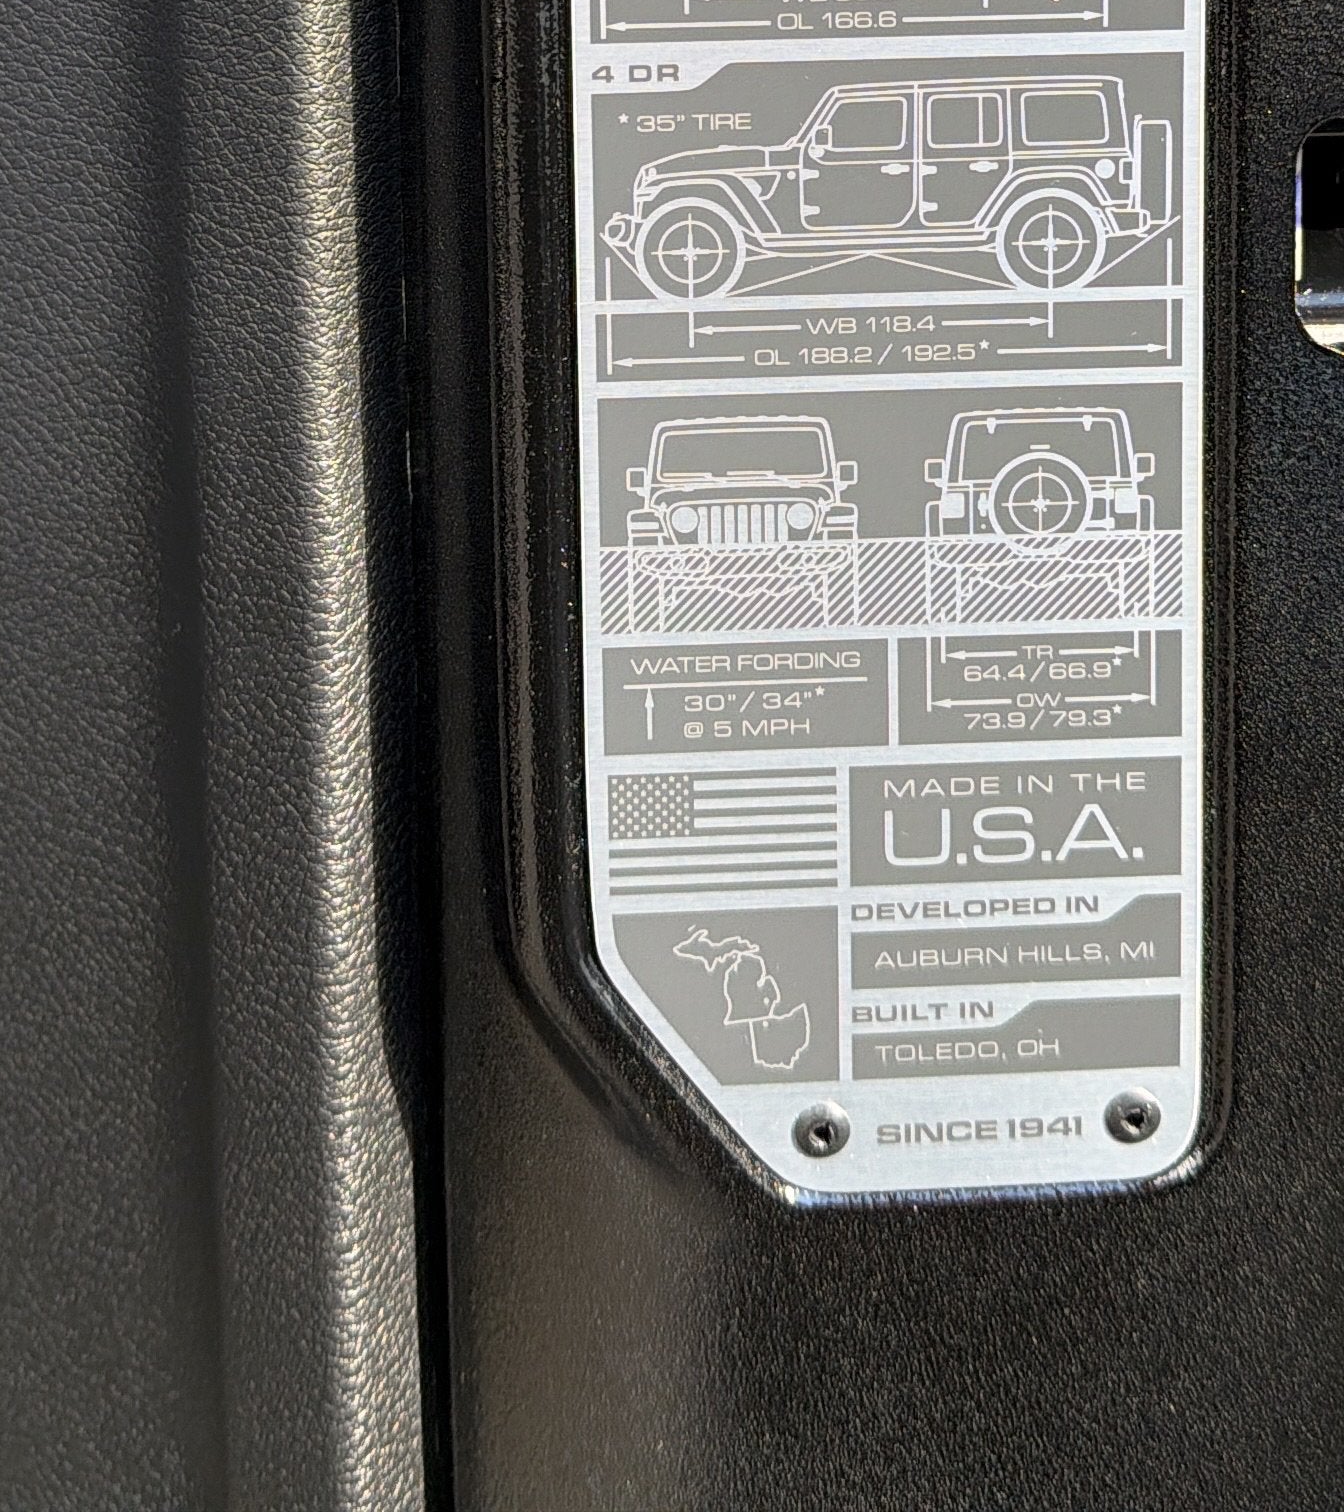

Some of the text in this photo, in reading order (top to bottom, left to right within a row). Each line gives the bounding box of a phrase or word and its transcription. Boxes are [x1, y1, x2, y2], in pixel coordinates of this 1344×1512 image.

[777, 10, 897, 31] OL 166.6
[591, 63, 680, 84] 4 DR
[691, 112, 752, 131] TIRE
[805, 314, 936, 335] WB 118.4
[754, 348, 791, 366] OL
[798, 346, 873, 365] 188.2
[630, 650, 861, 676] WATER FORDING
[1021, 644, 1054, 660] TR
[1016, 691, 1062, 708] OW
[683, 717, 810, 739] @ 5 MPH
[883, 771, 1146, 799] MADE IN THE
[884, 803, 1144, 867] U.S.A.
[850, 895, 1099, 922] DEVELOPED IN
[874, 940, 1154, 970] AUBURN HILLS, MI
[851, 1000, 994, 1024] BUILT IN
[874, 1038, 1060, 1063] TOLEDO, OH
[876, 1116, 1082, 1147] SINCE 1941
